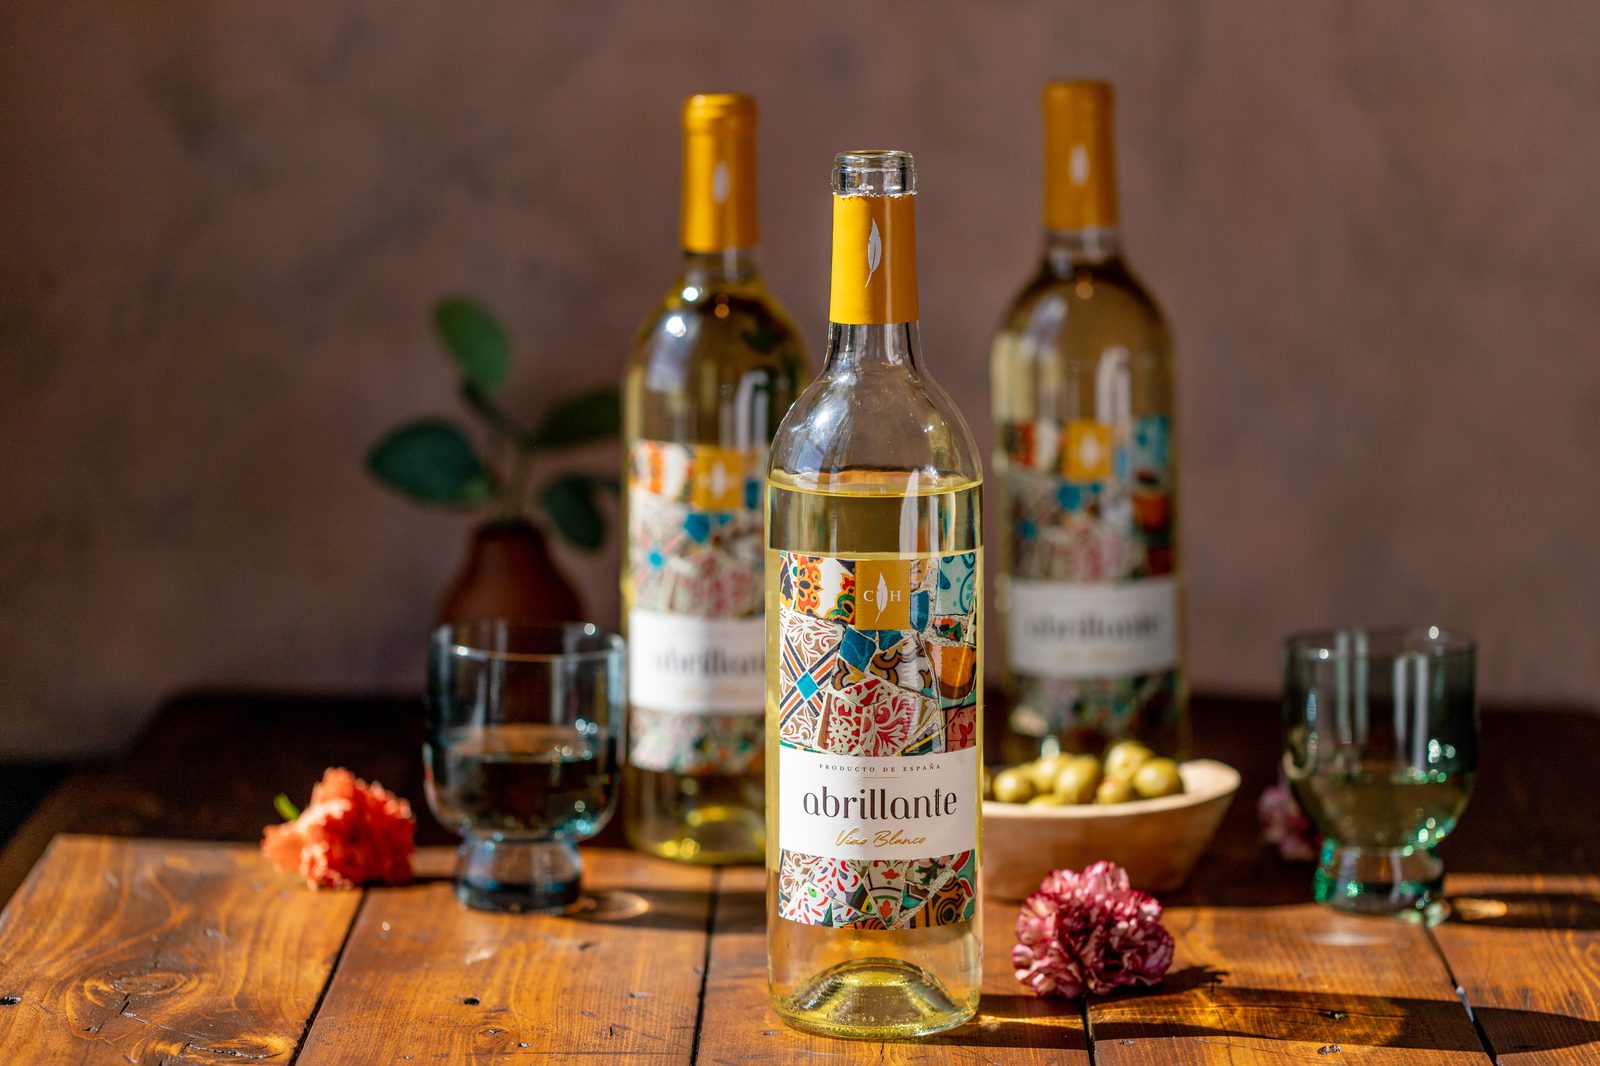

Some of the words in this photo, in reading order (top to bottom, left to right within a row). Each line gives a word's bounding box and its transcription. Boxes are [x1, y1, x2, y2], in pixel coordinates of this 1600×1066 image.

[863, 590, 874, 602] C
[890, 590, 901, 602] H
[819, 763, 876, 773] PRODUCTO
[902, 762, 941, 772] ESPAÑA
[803, 786, 957, 820] abrillante
[834, 826, 868, 847] Vino
[873, 829, 926, 848] Blanco
